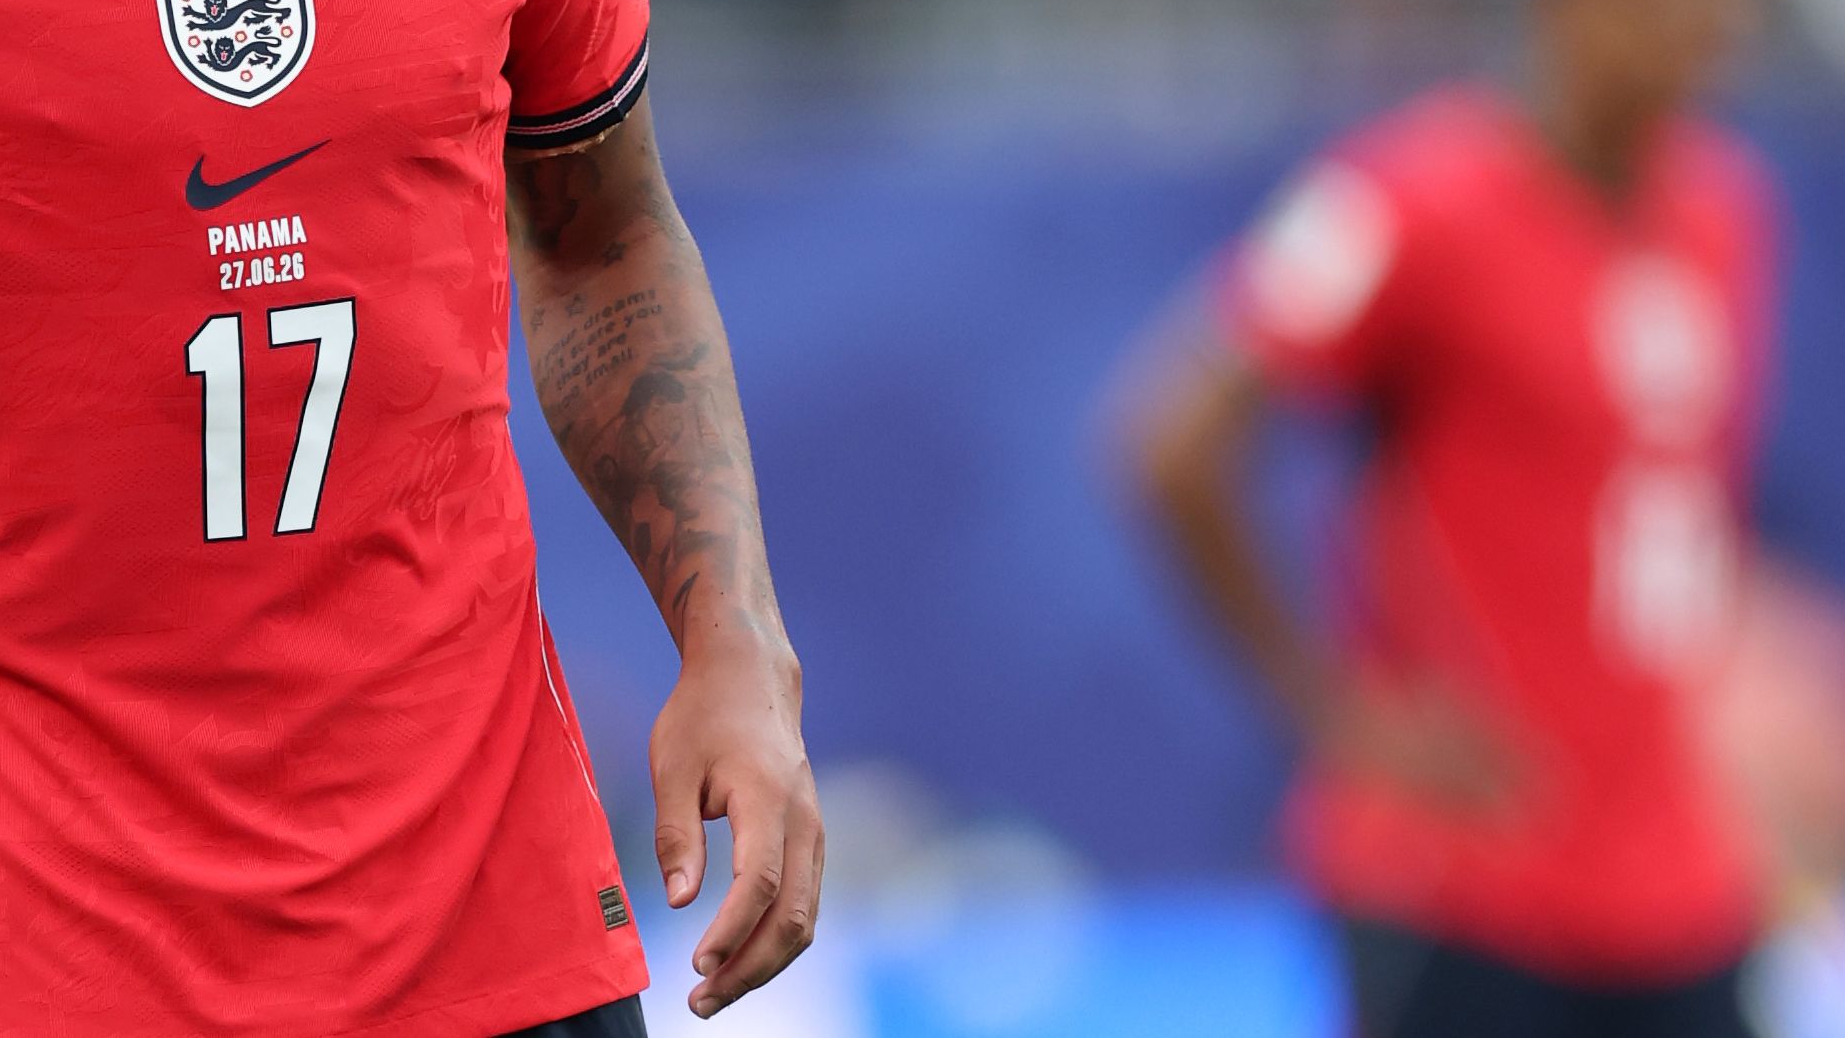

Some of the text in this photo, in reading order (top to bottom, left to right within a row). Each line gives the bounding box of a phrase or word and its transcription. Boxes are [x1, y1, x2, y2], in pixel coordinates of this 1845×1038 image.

[207, 215, 307, 256] PANAMA
[219, 251, 305, 290] 27.06.26
[184, 297, 358, 543] 17
